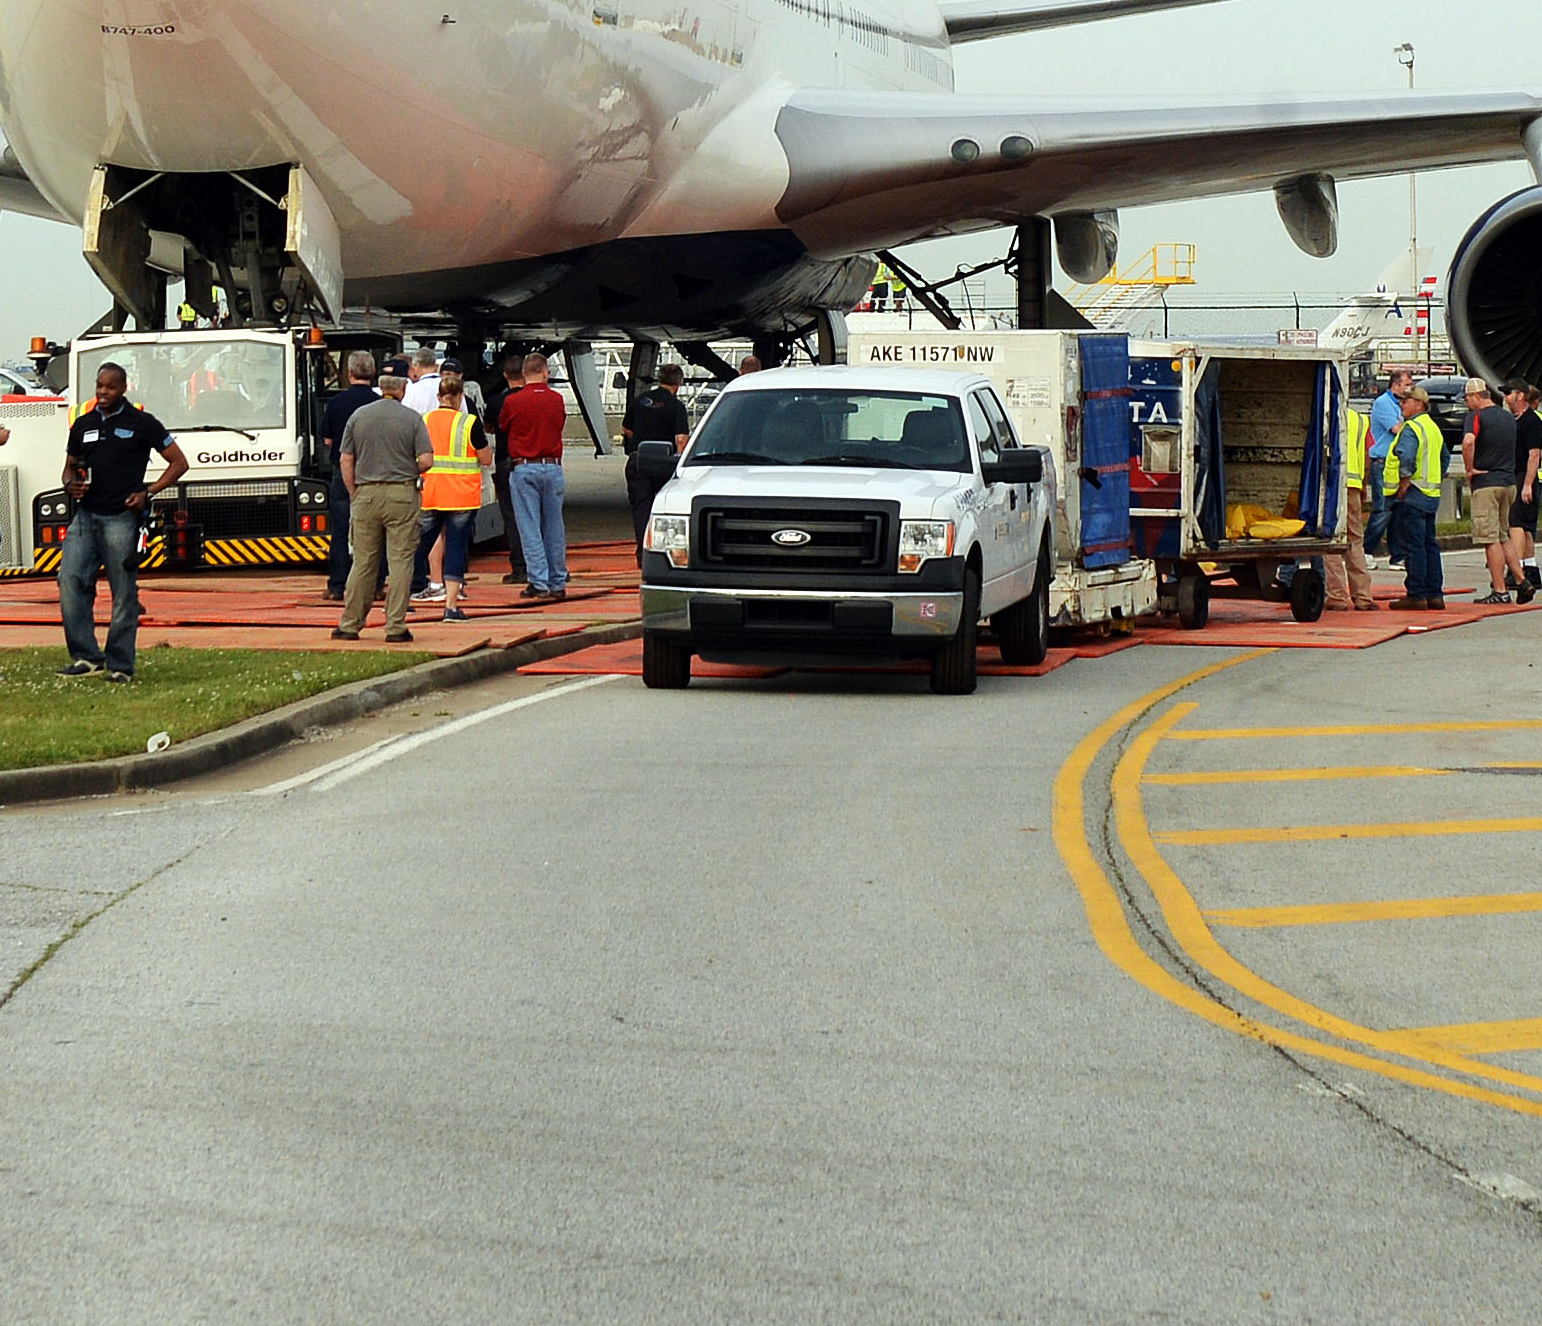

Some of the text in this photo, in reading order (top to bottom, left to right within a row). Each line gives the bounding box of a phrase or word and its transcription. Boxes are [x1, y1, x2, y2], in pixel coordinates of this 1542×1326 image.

[101, 25, 175, 36] B747-400
[870, 345, 995, 362] AKE 11571 NW
[197, 449, 285, 464] Goldhofer
